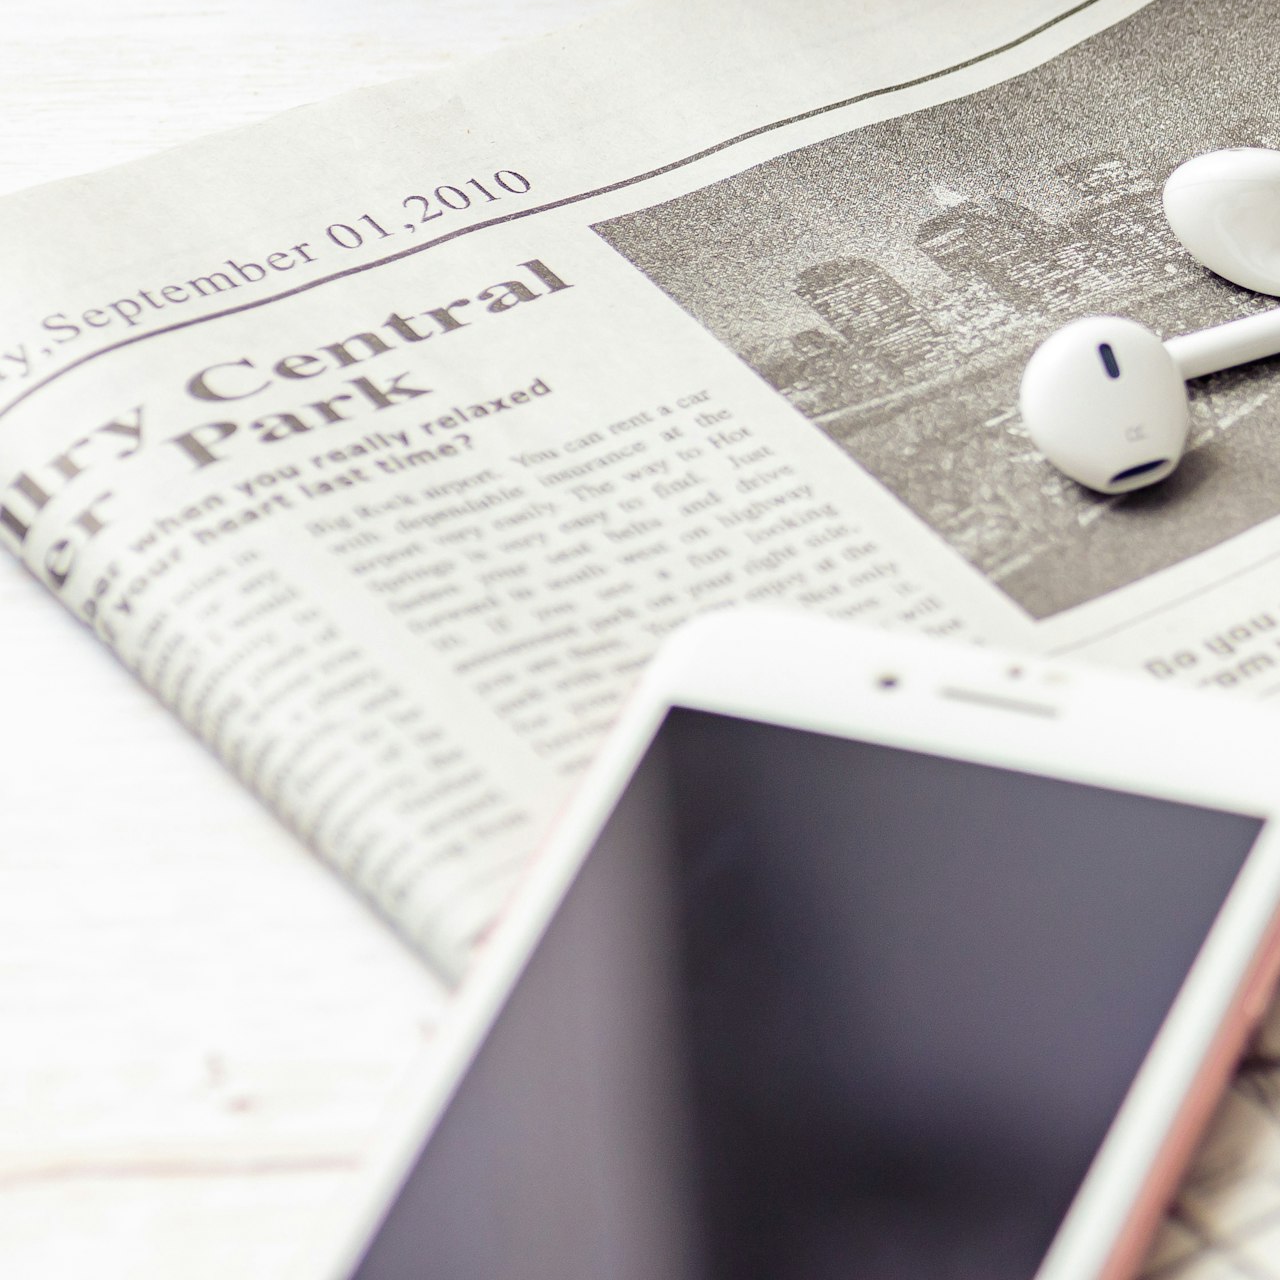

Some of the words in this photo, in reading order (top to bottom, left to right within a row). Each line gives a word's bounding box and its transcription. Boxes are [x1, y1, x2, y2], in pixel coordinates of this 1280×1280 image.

[0, 240, 317, 381] y,September
[326, 169, 532, 249] 01,2010
[185, 258, 577, 403] Central
[162, 369, 435, 470] Park
[508, 448, 559, 467] You
[563, 430, 605, 452] can
[606, 410, 654, 435] rent
[676, 388, 711, 408] car
[537, 440, 647, 487] insurance
[693, 408, 734, 427] the
[622, 458, 669, 482] way
[706, 426, 754, 449] Hot
[726, 445, 776, 470] Just
[131, 494, 224, 553] when
[235, 457, 301, 497] you
[309, 416, 411, 472] really
[418, 377, 553, 436] relaxed
[114, 547, 182, 615] your
[191, 491, 288, 546] heart
[299, 464, 373, 500] last
[377, 432, 474, 477] time?
[1199, 652, 1275, 686] om
[1203, 613, 1278, 658] you
